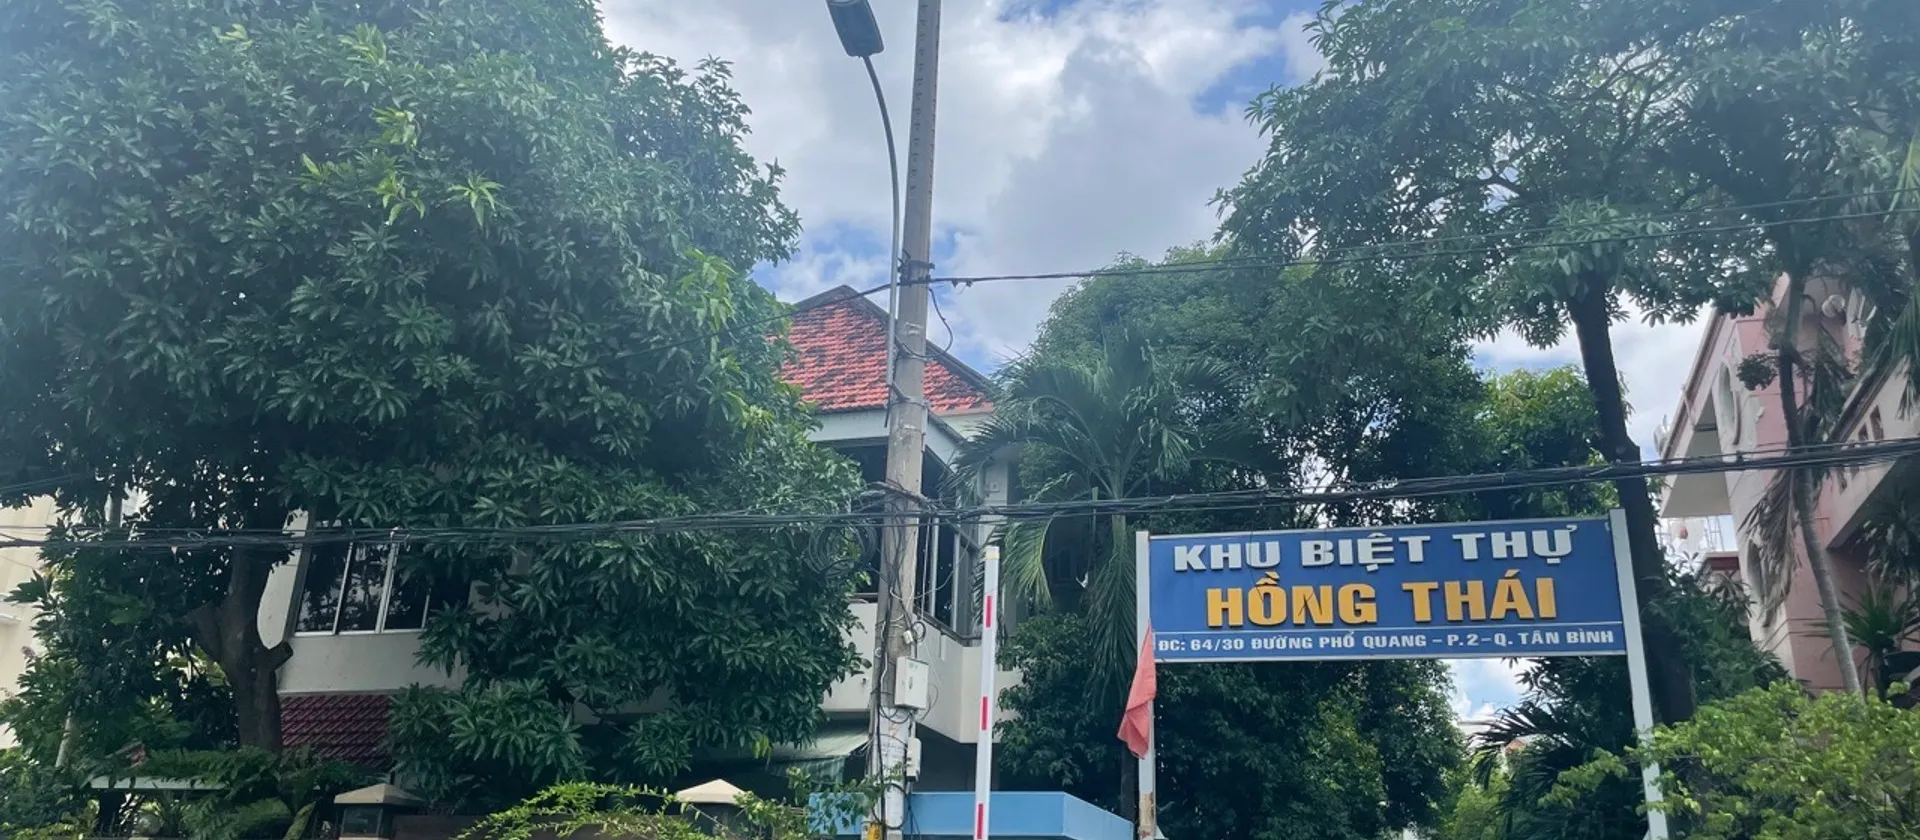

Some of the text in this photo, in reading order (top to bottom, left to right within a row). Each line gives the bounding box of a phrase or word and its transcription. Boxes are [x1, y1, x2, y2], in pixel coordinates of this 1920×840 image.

[1174, 524, 1578, 572] KHU BIỆT THỰ
[1206, 568, 1557, 628] HỒNG THÁI
[1158, 639, 1186, 652] ĐC:
[1190, 637, 1245, 652] 64/30
[1251, 633, 1314, 650] ĐƯỜNG
[1362, 634, 1427, 649] QUANG
[1518, 630, 1560, 645] TÂN
[1566, 629, 1614, 644] BÌNH
